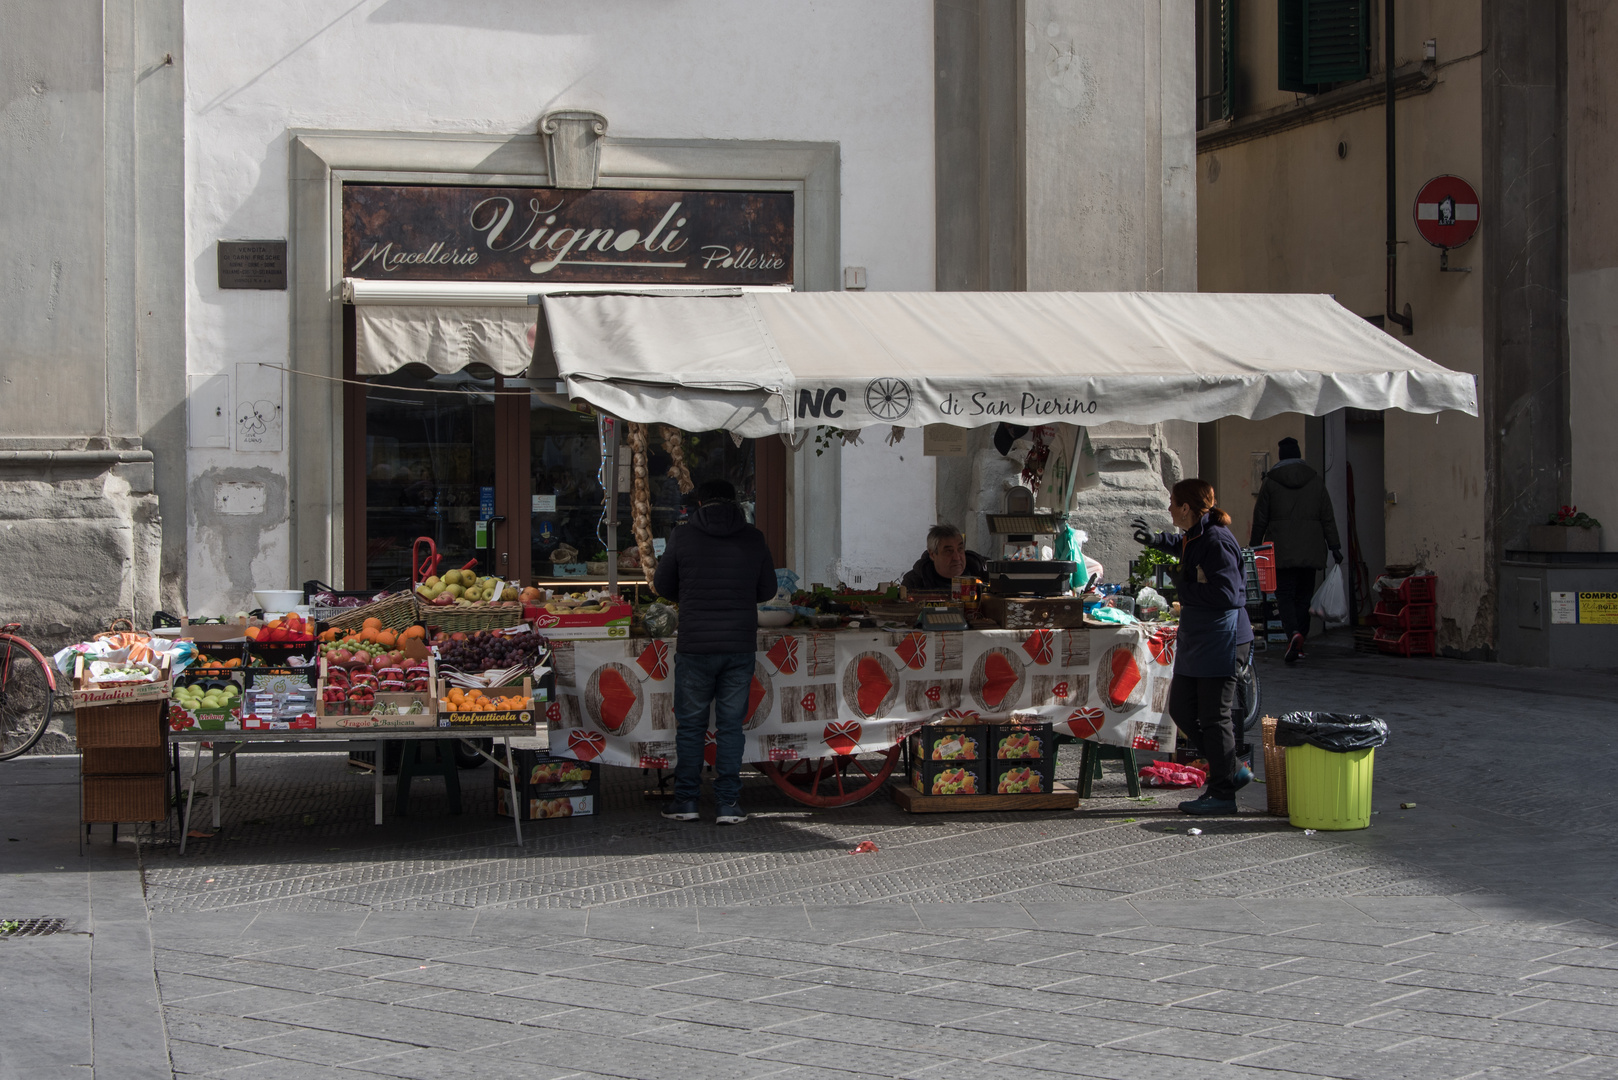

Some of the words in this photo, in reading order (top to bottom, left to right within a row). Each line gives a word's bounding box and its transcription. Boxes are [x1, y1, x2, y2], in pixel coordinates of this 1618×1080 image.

[351, 242, 480, 272] Macellerie
[470, 196, 688, 274] Vignoli
[700, 244, 786, 270] Pollerie
[794, 387, 847, 419] NC
[939, 391, 963, 416] di
[969, 391, 1016, 416] San
[1020, 392, 1097, 416] Pierino
[539, 617, 558, 627] Opera
[80, 688, 134, 703] Natalini
[343, 719, 371, 728] Fragole
[380, 719, 416, 727] Basilicata
[449, 711, 517, 724] Ortofrutticola
